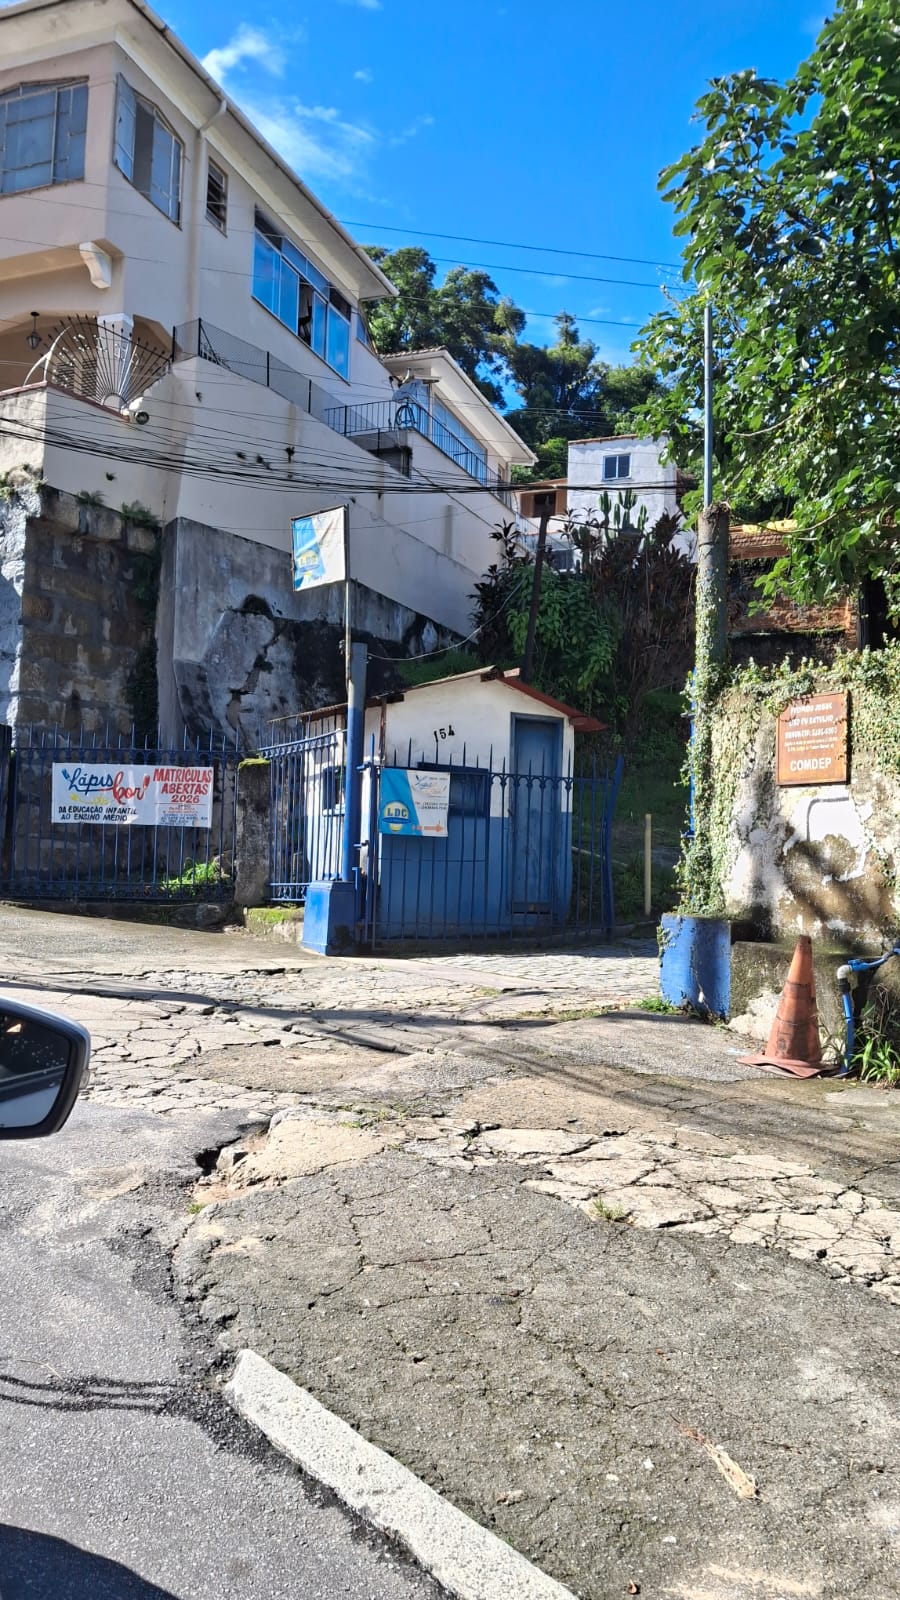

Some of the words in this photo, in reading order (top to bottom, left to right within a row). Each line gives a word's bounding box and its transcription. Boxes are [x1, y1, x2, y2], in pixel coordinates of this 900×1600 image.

[433, 725, 455, 742] 154
[789, 757, 832, 772] COMDEP
[68, 767, 114, 796] Lápis
[161, 783, 208, 795] ABERTAS
[171, 795, 200, 804] 2026
[58, 805, 67, 813] DA
[68, 804, 103, 814] EDUCAÇÃO
[106, 806, 137, 815] INFANTIL
[387, 807, 408, 818] LDC
[73, 813, 100, 821] ENSINO
